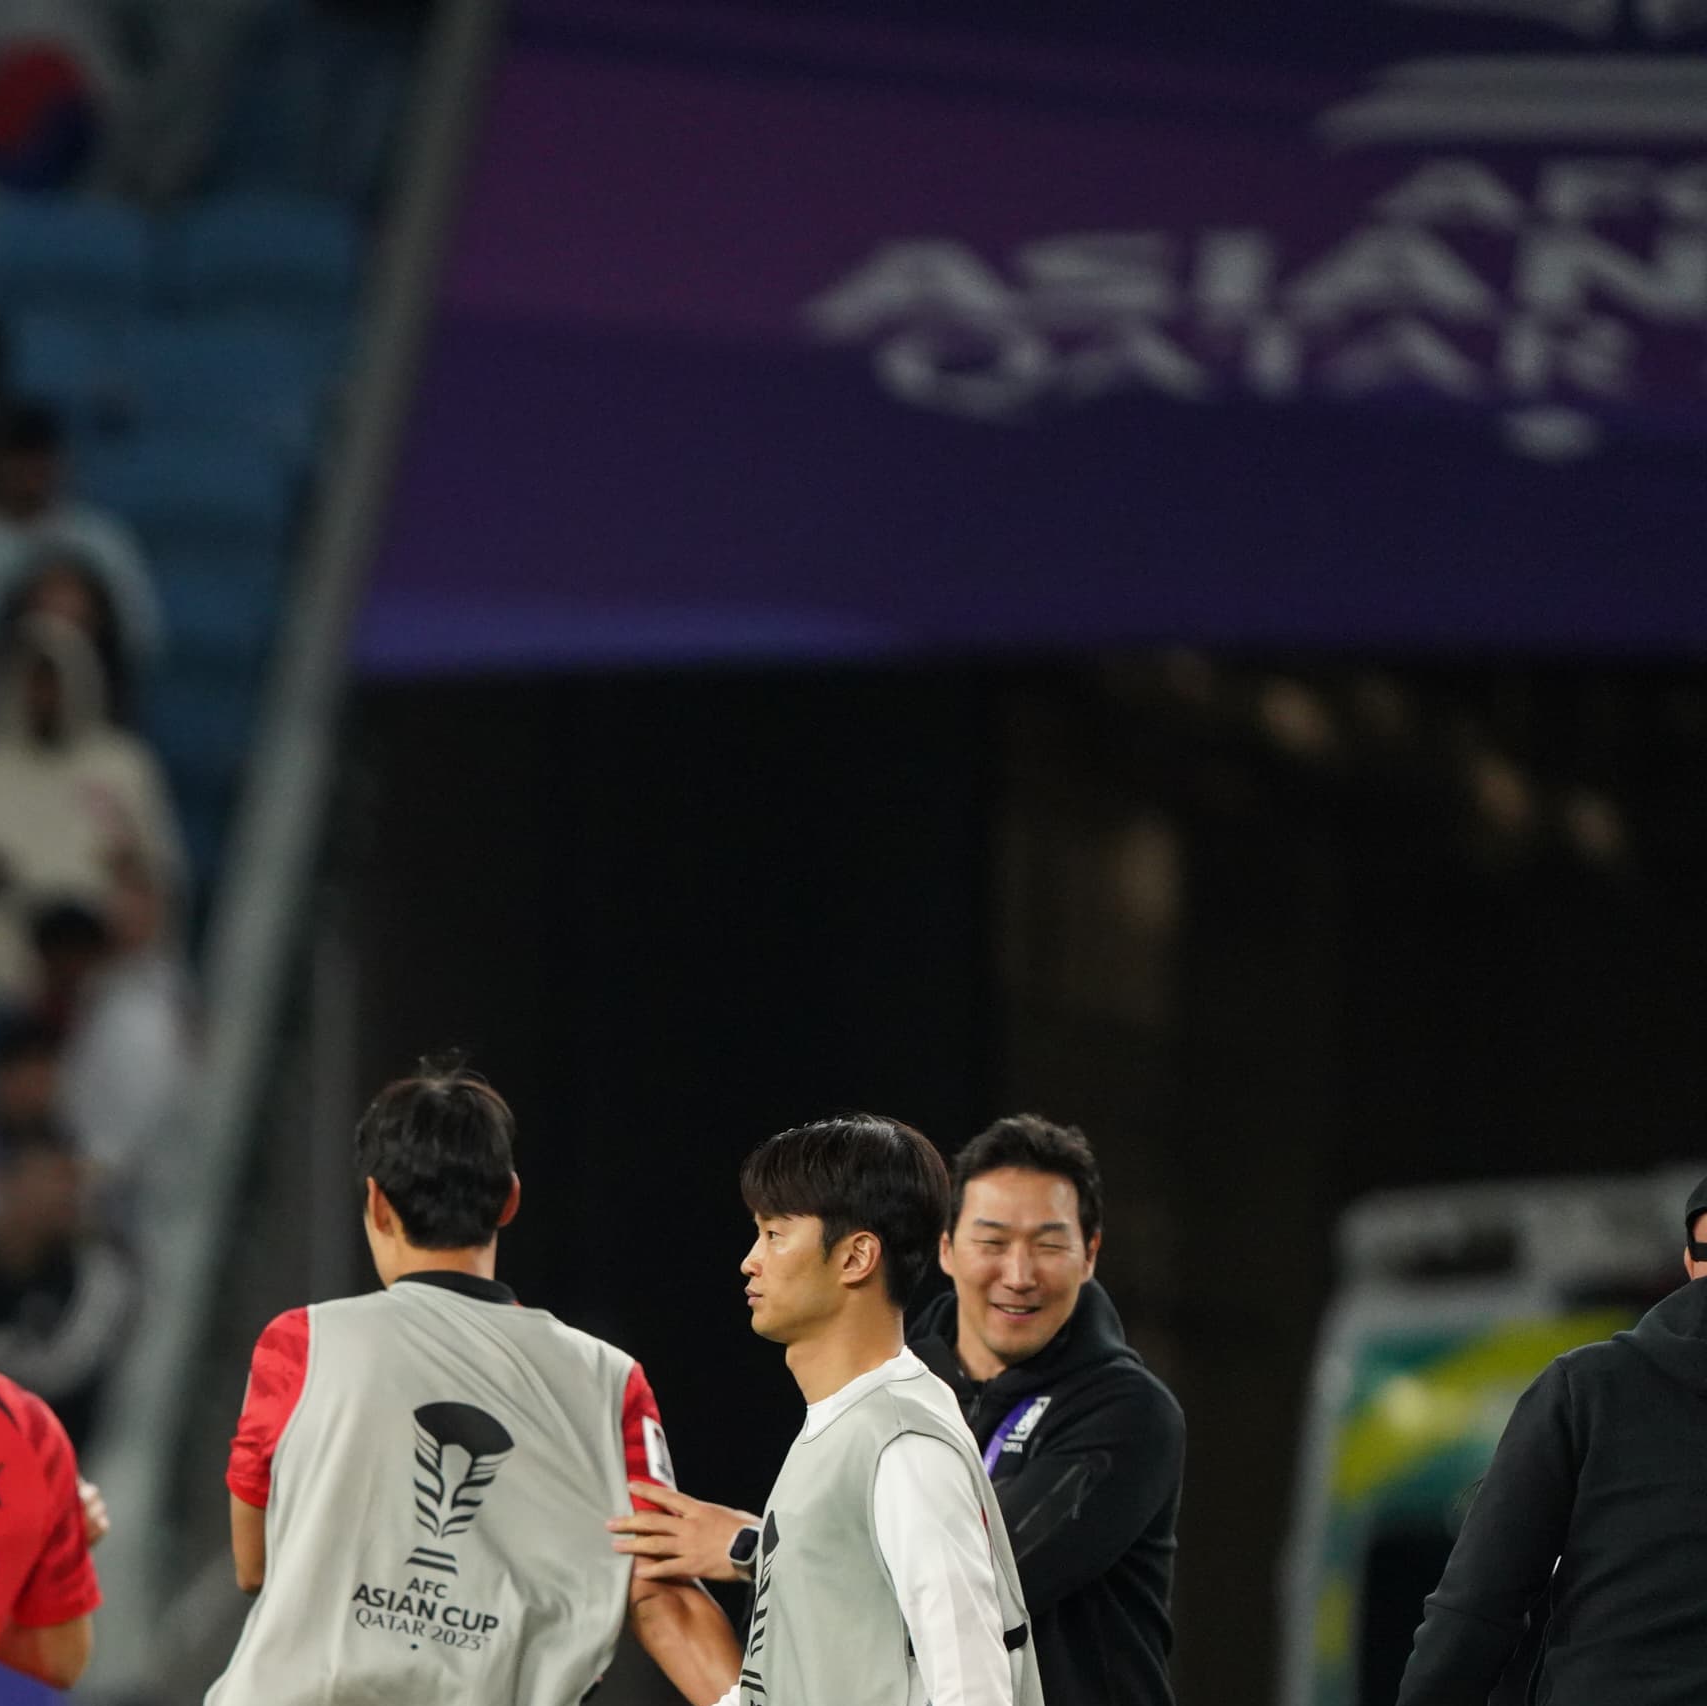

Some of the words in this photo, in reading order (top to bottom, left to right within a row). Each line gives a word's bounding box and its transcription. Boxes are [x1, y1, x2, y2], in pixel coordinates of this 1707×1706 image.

[352, 1583, 438, 1621] ASIAN
[442, 1606, 500, 1634] CUP
[406, 1577, 449, 1599] AFC
[355, 1607, 427, 1638] QATAR
[430, 1625, 482, 1651] 2023
